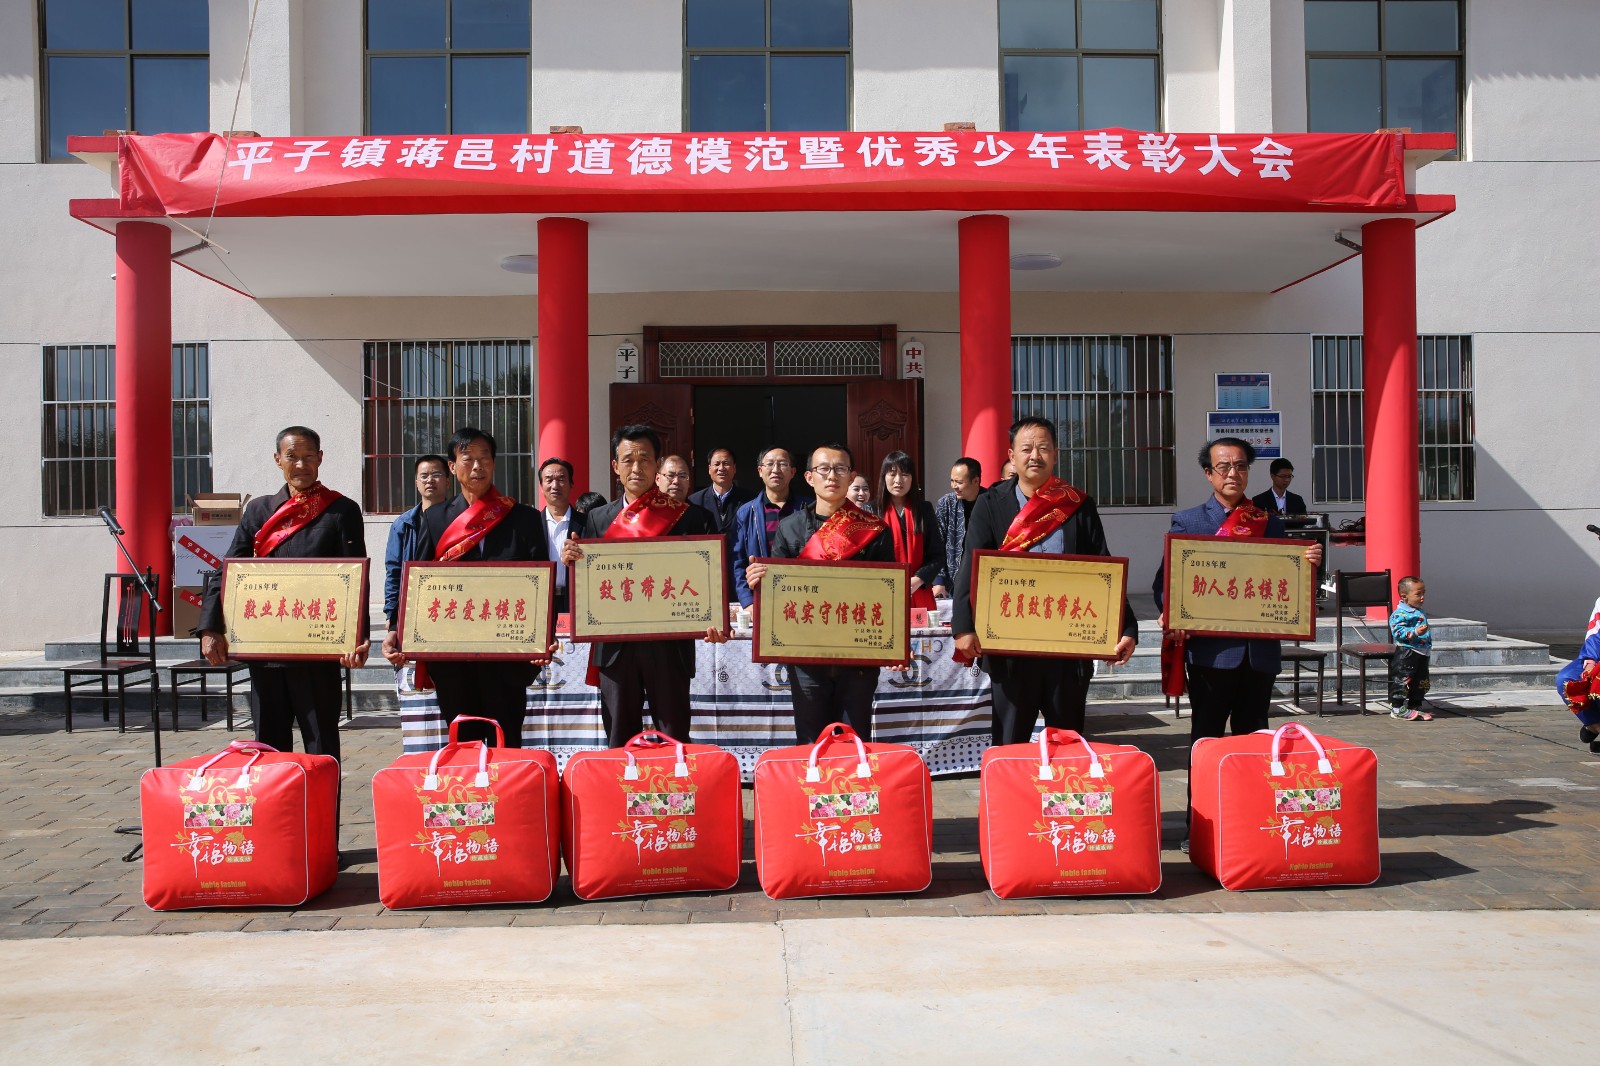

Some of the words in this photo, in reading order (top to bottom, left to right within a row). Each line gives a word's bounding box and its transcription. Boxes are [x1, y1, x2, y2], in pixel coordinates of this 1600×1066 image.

[228, 132, 1294, 181] 平子镇蒋邑村道德模范暨优秀少年表彰大会
[617, 347, 637, 379] 平子
[905, 347, 923, 379] 中共
[596, 562, 634, 571] 2018年度
[1190, 560, 1227, 569] 2018年度
[427, 584, 464, 592] 2018年度
[599, 575, 699, 603] 致富带头人
[781, 585, 819, 594] 2018年度
[999, 578, 1036, 588] 2018年度
[1192, 575, 1290, 602] 助人为乐模范
[243, 596, 338, 622] 敬业奉献模范
[427, 597, 527, 622] 孝老爱亲模范
[783, 600, 884, 627] 诚实守信模范
[1000, 592, 1097, 621] 党员致富带头人
[612, 820, 697, 865] 幸福物语
[795, 821, 882, 866] 幸福物语
[1028, 820, 1116, 866] 幸福物语
[1260, 815, 1342, 860] 幸福物语
[170, 832, 255, 878] 幸福物语
[410, 831, 499, 877] 幸福物语
[464, 878, 491, 886] fashion
[663, 866, 688, 874] fashion
[850, 868, 875, 876] fashion
[1081, 868, 1106, 876] fashion
[200, 881, 219, 889] Noble
[221, 880, 246, 888] fashion
